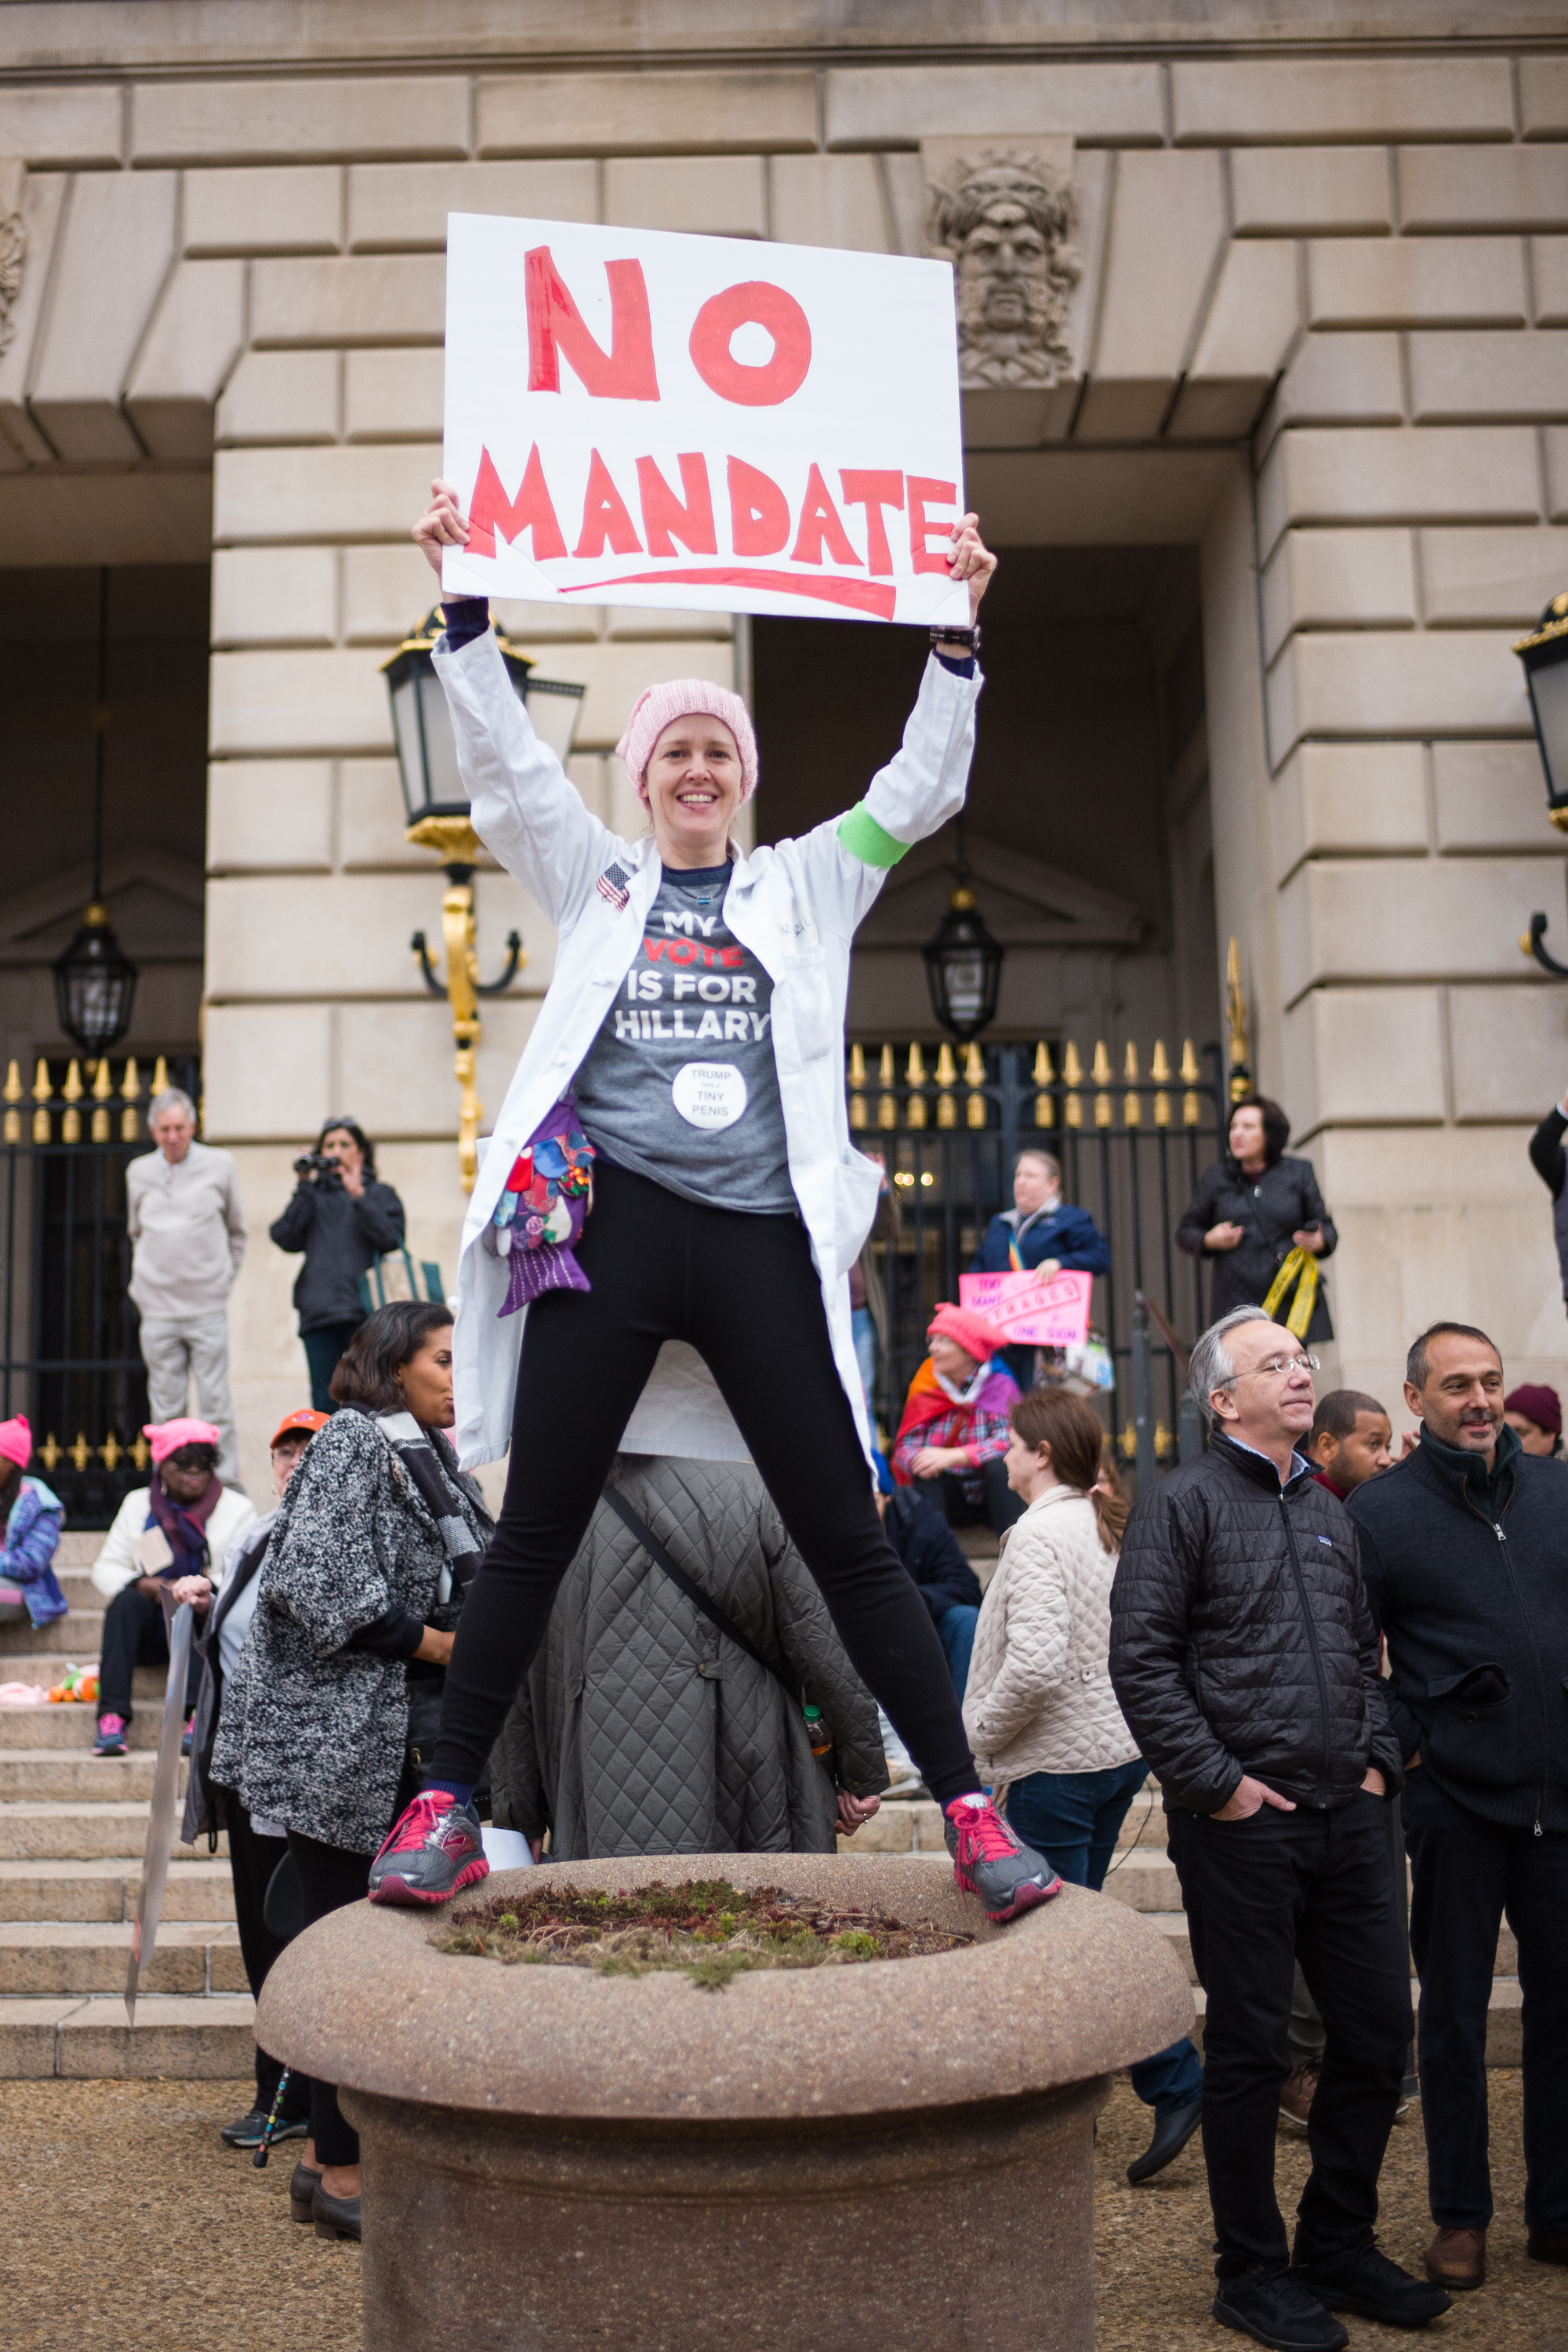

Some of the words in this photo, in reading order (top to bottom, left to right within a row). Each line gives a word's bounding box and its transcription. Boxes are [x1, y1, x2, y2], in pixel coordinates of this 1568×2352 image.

[524, 245, 811, 406] NO
[463, 441, 956, 575] MANDATE
[663, 910, 717, 937] MY
[643, 938, 743, 967] VOTE
[627, 970, 663, 1000] IS
[673, 974, 757, 1003] FOR
[615, 1010, 771, 1041] HILLARY
[691, 1069, 731, 1080] TRUMP
[692, 1105, 728, 1116] PENIS
[697, 1091, 724, 1101] TINY
